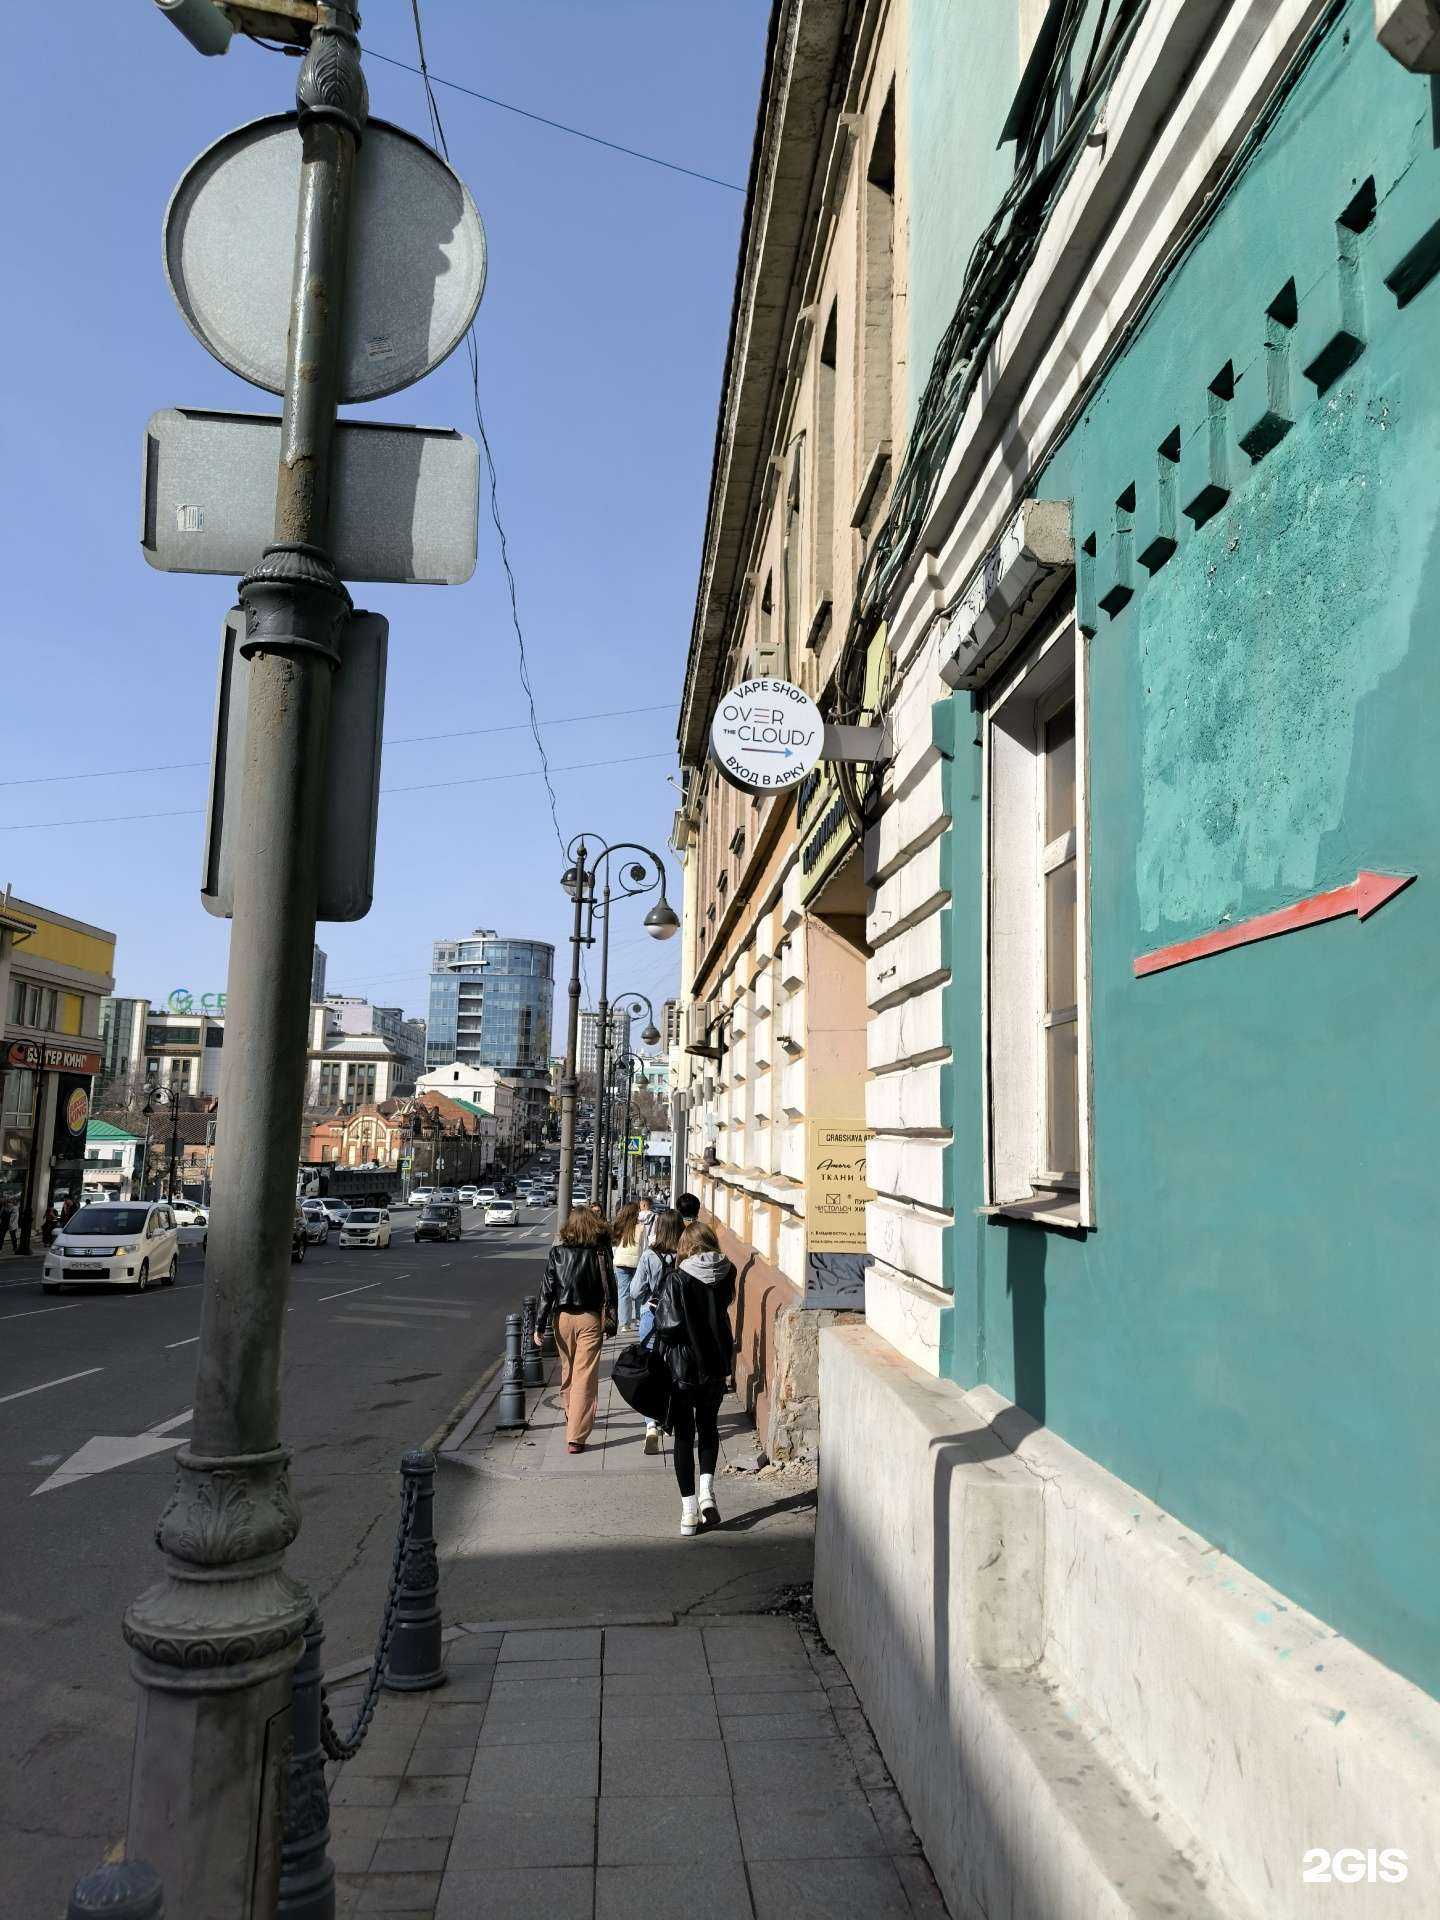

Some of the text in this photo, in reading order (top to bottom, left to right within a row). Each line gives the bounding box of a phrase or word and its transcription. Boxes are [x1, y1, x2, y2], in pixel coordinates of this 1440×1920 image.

[734, 681, 807, 705] VAPE SHOP
[723, 705, 784, 725] OVER
[737, 725, 815, 746] CLOUDS
[725, 756, 805, 785] ВХОД В АРКУ
[63, 1051, 87, 1068] КИНГ
